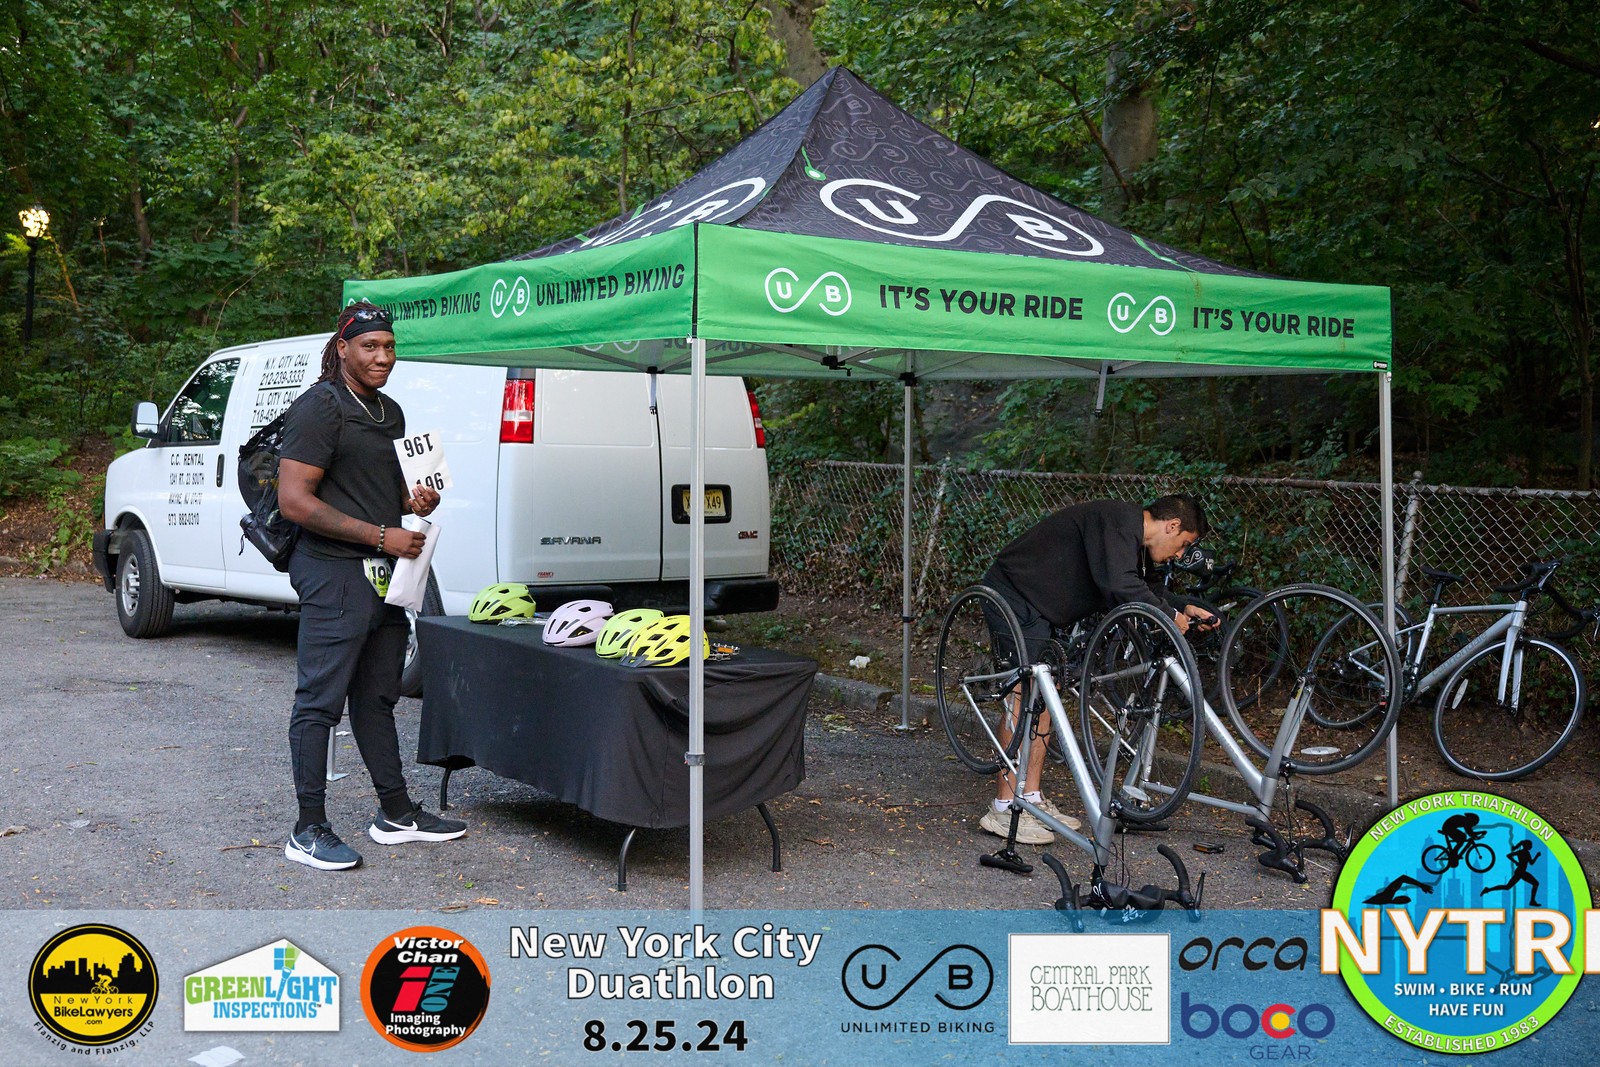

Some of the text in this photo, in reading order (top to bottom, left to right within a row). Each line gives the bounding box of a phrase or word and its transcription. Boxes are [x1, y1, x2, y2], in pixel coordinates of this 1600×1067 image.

[1006, 213, 1068, 241] B
[536, 263, 685, 307] UNLIMITED BIKING
[776, 281, 842, 302] U B
[440, 292, 481, 317] BIKING
[940, 288, 1015, 317] YOUR
[1023, 294, 1083, 320] RIDE
[1117, 305, 1168, 324] U B
[1241, 310, 1301, 336] YOUR
[1307, 316, 1355, 339] RIDE
[278, 354, 294, 368] CITY
[294, 353, 310, 367] CALL
[260, 369, 306, 386] 212-239-3333
[267, 391, 282, 406] CITY
[170, 453, 205, 466] C.C. RENTAL
[168, 512, 177, 526] 973
[540, 536, 602, 546] SAVANA
[738, 530, 758, 540] GMC
